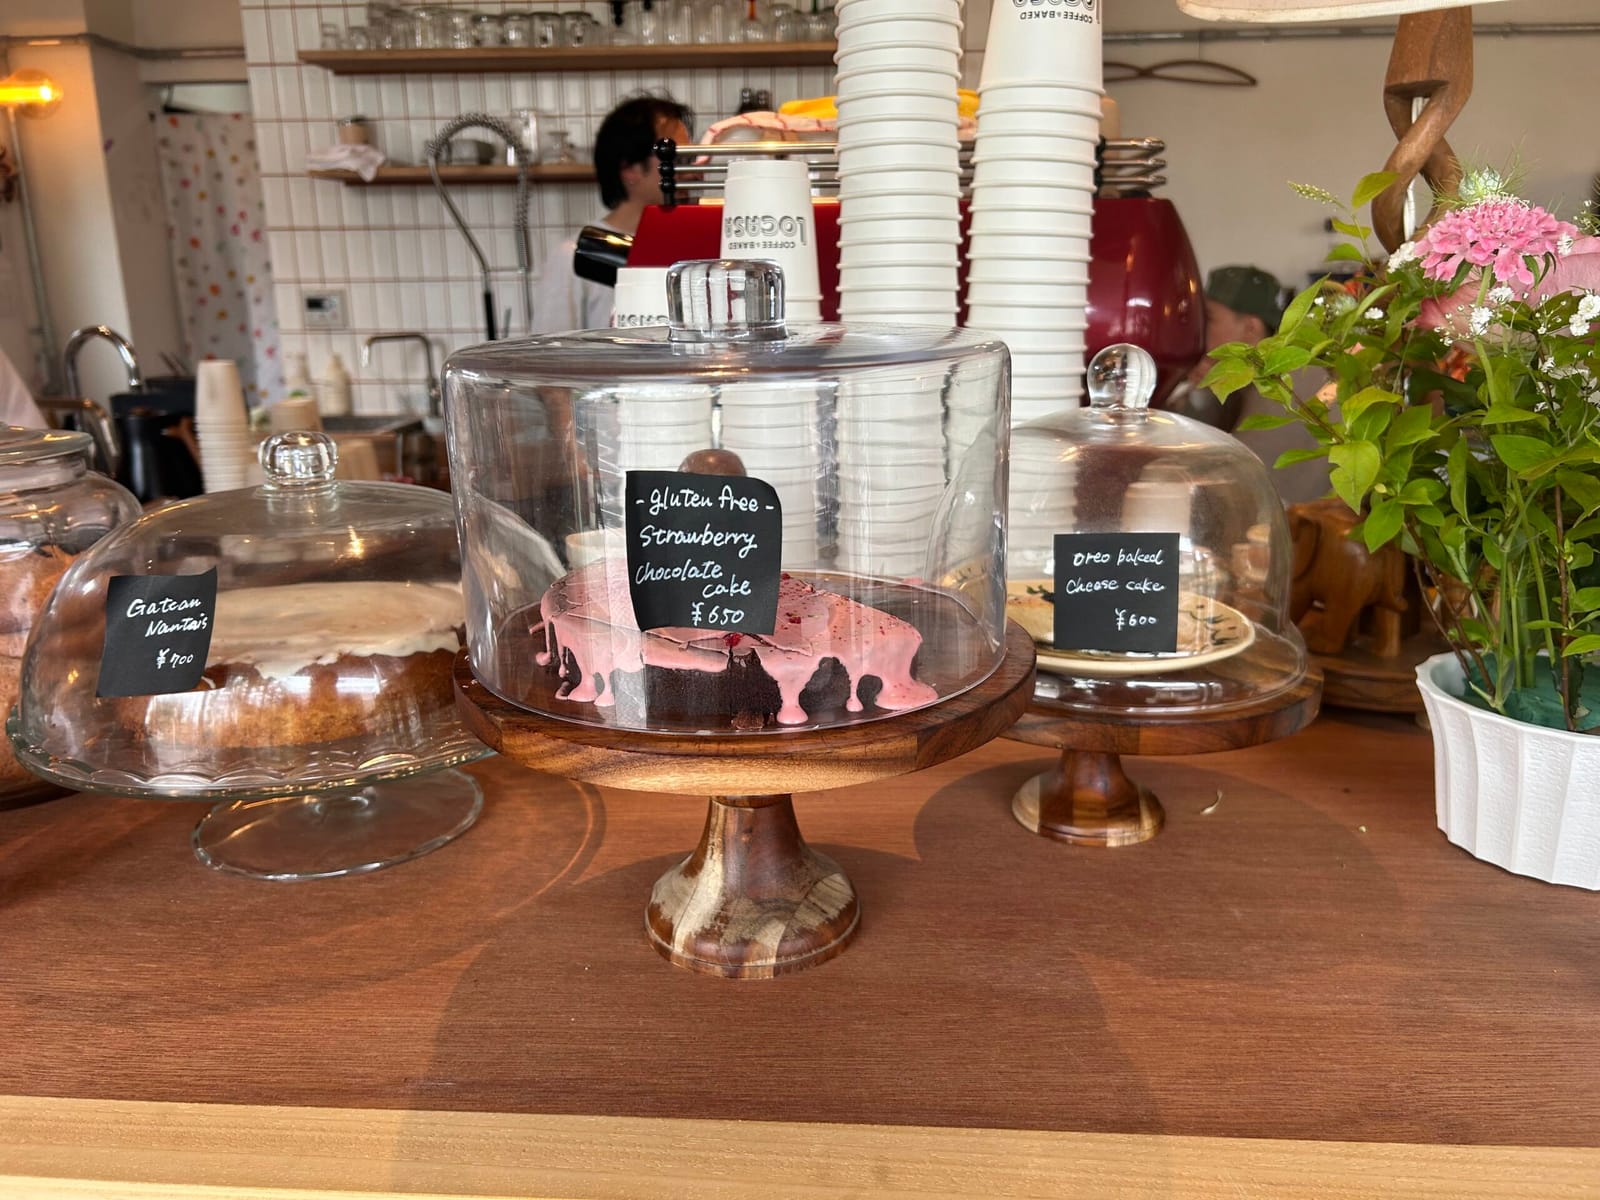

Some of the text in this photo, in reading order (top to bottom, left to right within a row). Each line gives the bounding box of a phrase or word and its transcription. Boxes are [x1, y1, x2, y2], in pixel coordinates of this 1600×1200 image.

[1019, 10, 1056, 20] BAKED
[1063, 10, 1093, 24] COFFEE
[728, 240, 755, 250] BAKED
[762, 240, 796, 249] COFFEE
[649, 486, 713, 516] gluten
[717, 484, 759, 513] free
[639, 523, 758, 559] Strawberry
[1116, 547, 1164, 566] baked
